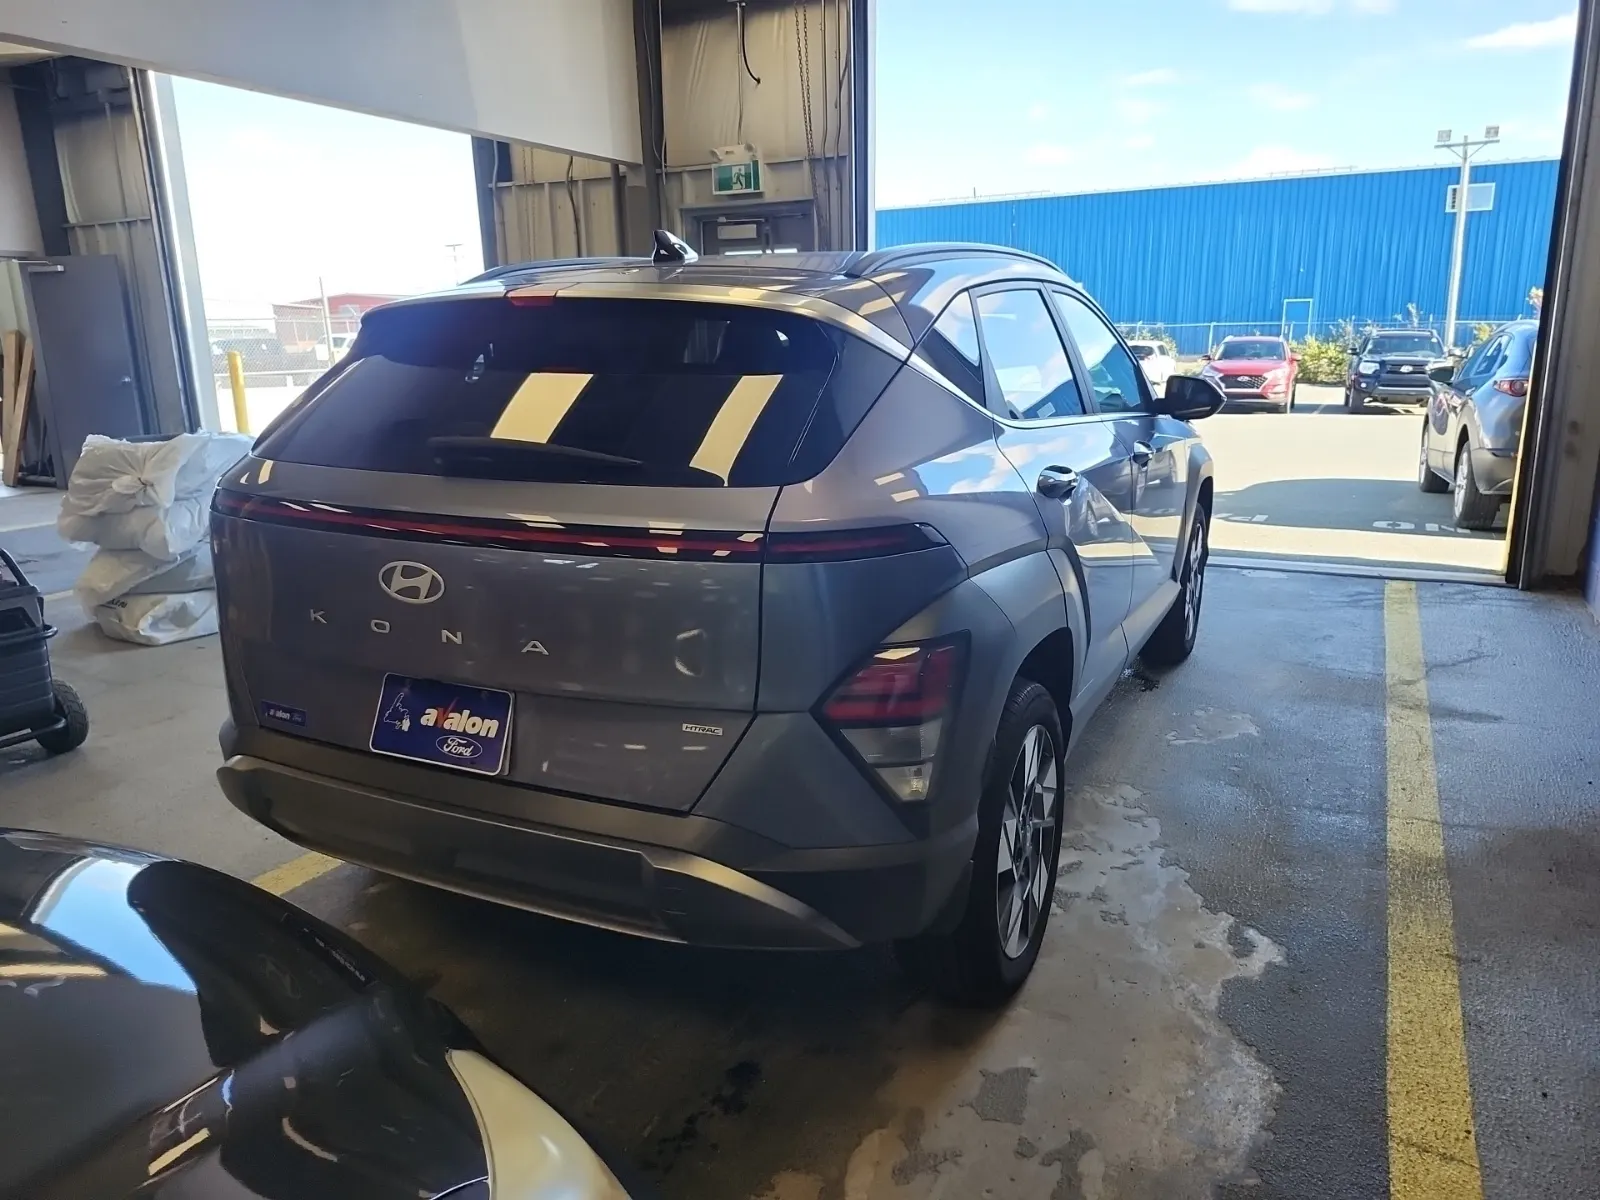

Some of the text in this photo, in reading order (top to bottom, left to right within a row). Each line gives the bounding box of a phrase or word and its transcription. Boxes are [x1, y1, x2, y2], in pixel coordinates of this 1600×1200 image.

[309, 608, 550, 656] KONA
[269, 708, 291, 720] aalon
[420, 697, 500, 739] avalon
[684, 724, 722, 735] HTRAC
[443, 736, 475, 757] Ford
